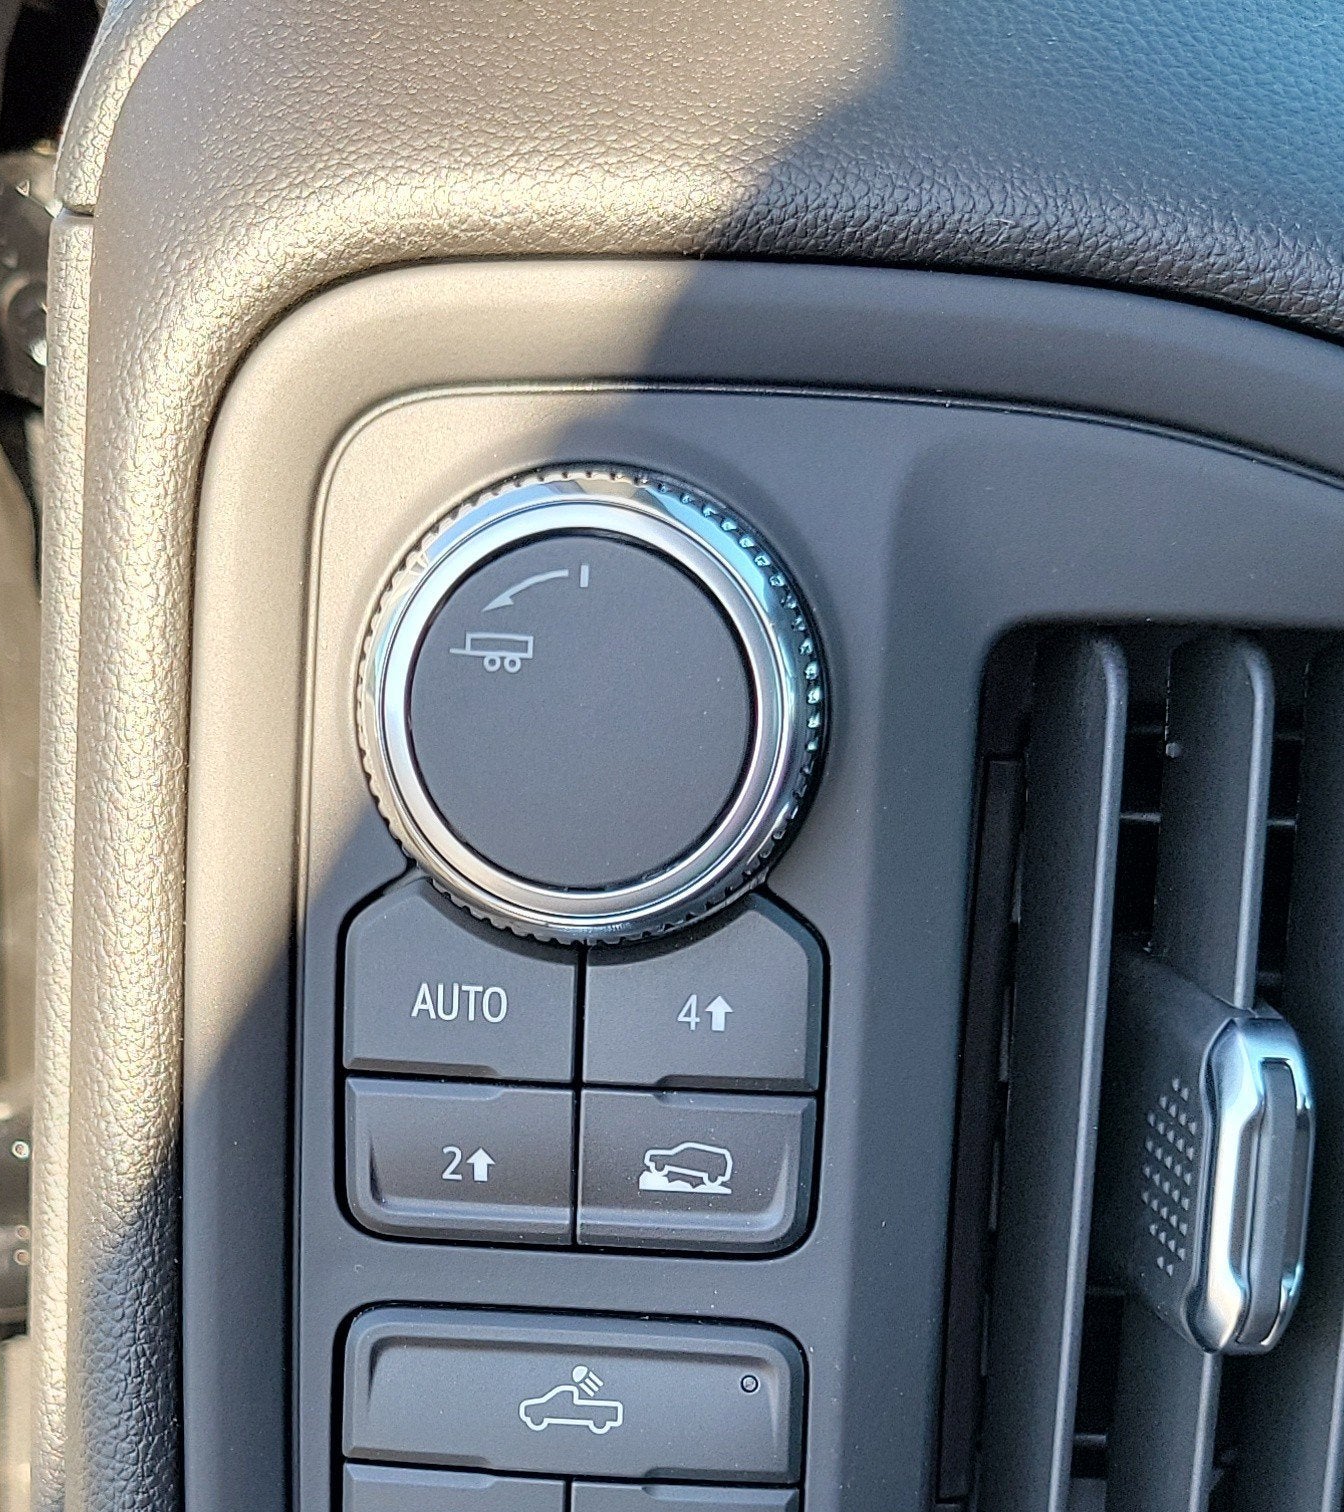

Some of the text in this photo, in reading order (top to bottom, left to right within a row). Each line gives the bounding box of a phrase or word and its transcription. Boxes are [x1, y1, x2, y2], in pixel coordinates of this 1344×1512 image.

[411, 984, 509, 1023] AUTO
[677, 992, 701, 1030] 4
[441, 1146, 463, 1182] 2
